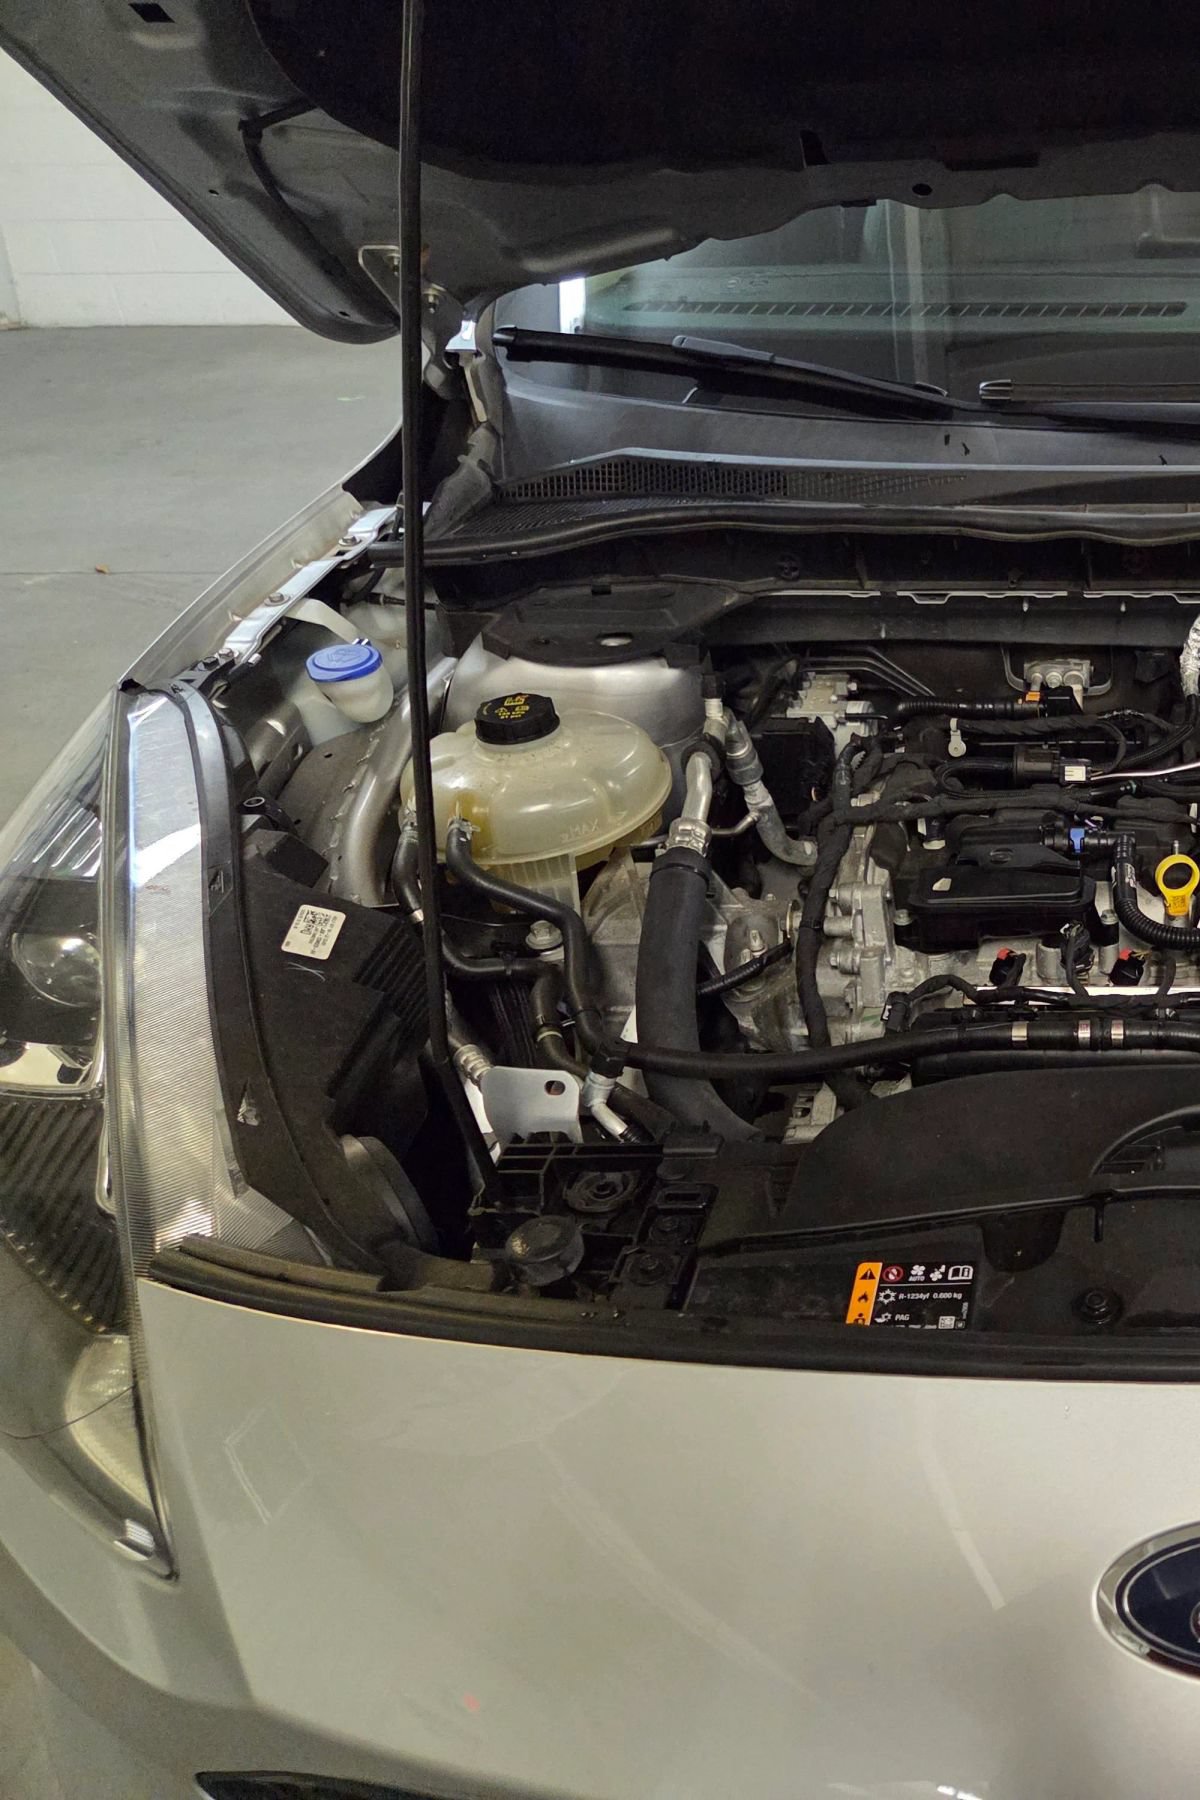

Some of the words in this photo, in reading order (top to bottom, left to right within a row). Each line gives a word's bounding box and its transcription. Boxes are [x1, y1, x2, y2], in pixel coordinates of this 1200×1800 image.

[569, 817, 601, 839] MAX
[898, 1292, 930, 1300] R-1234yf
[953, 1292, 963, 1300] kg
